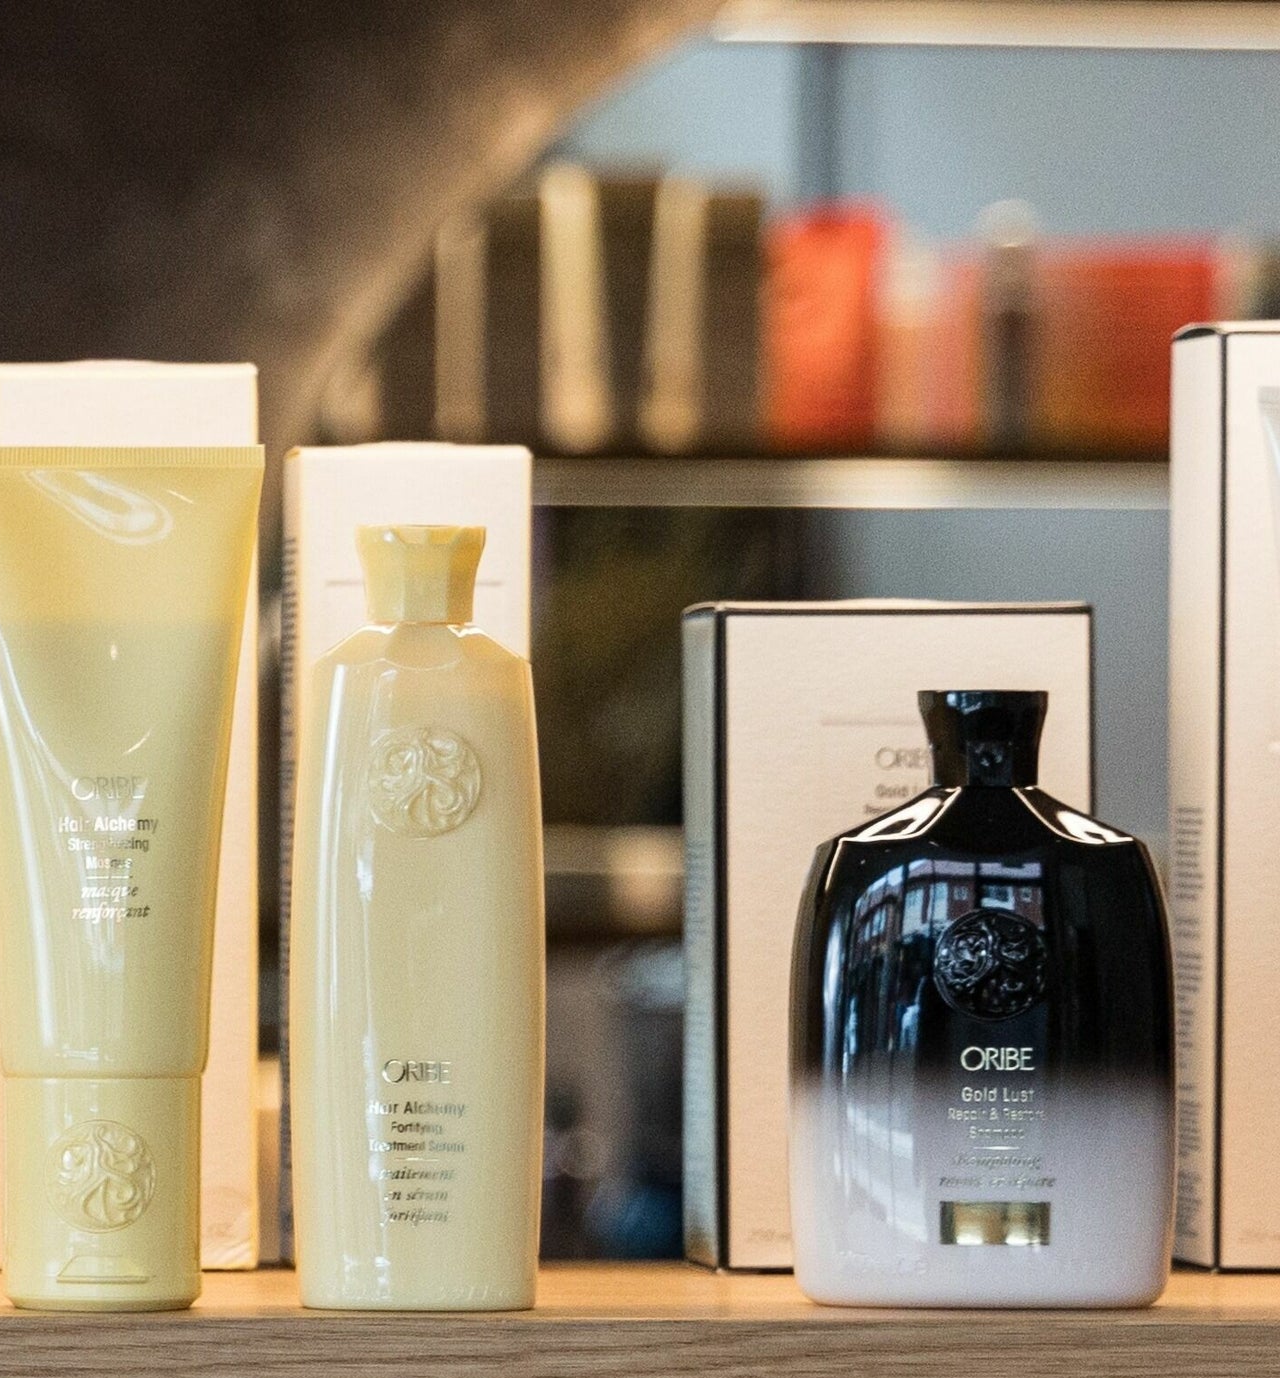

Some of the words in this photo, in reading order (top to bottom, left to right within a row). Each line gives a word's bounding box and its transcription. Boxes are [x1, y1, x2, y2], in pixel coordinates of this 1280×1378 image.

[93, 815, 160, 834] Alchemy
[960, 1046, 1036, 1072] ORIBE
[382, 1059, 452, 1084] ORIBE
[961, 1086, 997, 1103] Gold
[1003, 1087, 1035, 1103] Lust
